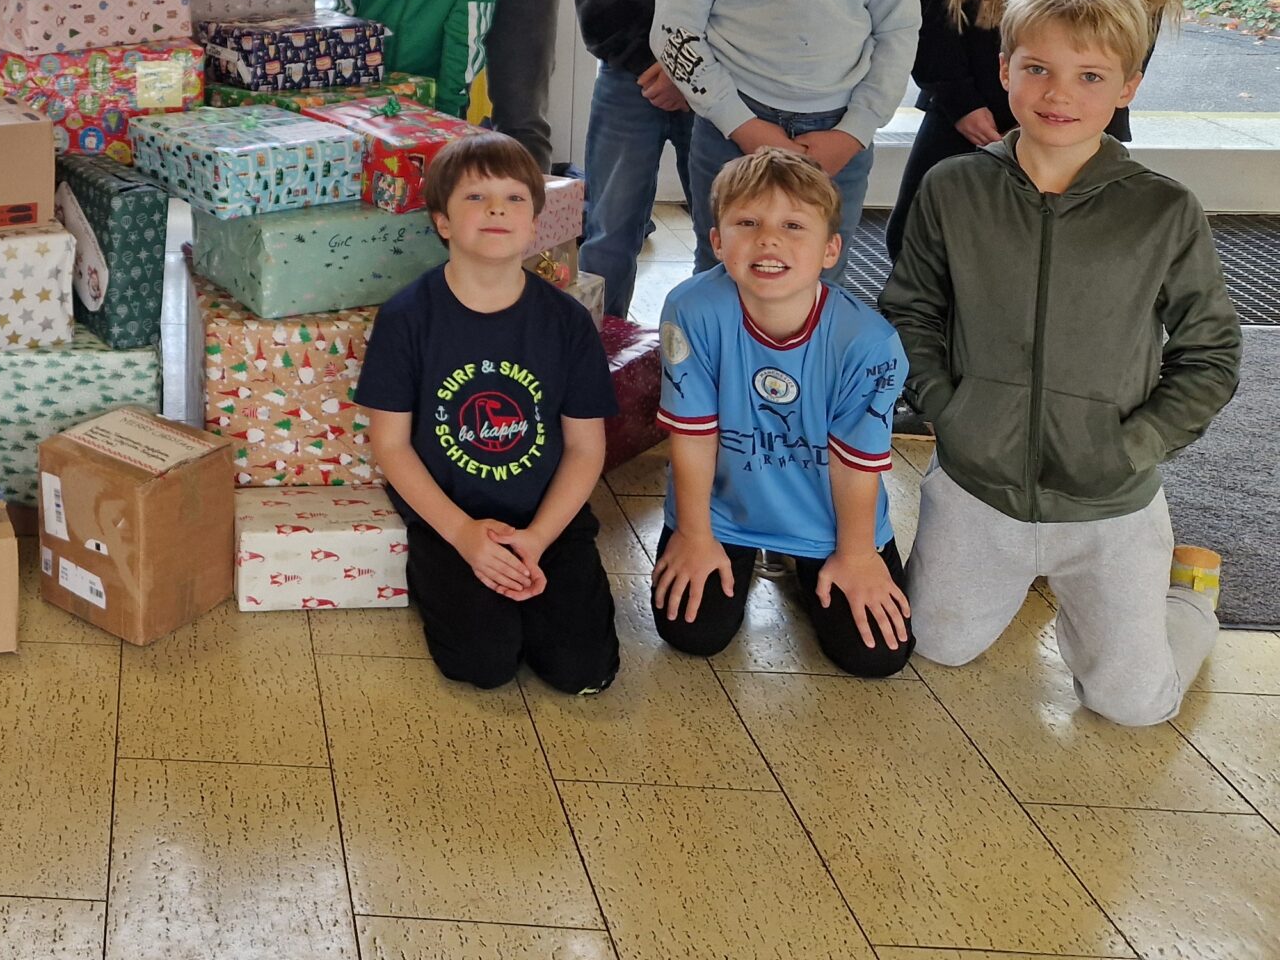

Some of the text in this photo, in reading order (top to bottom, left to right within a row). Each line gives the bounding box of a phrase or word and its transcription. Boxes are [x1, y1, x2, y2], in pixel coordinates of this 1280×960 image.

[437, 363, 476, 400] SURF
[481, 360, 496, 373] &
[459, 420, 528, 441] be happy
[435, 423, 545, 481] SCHIETWETTER
